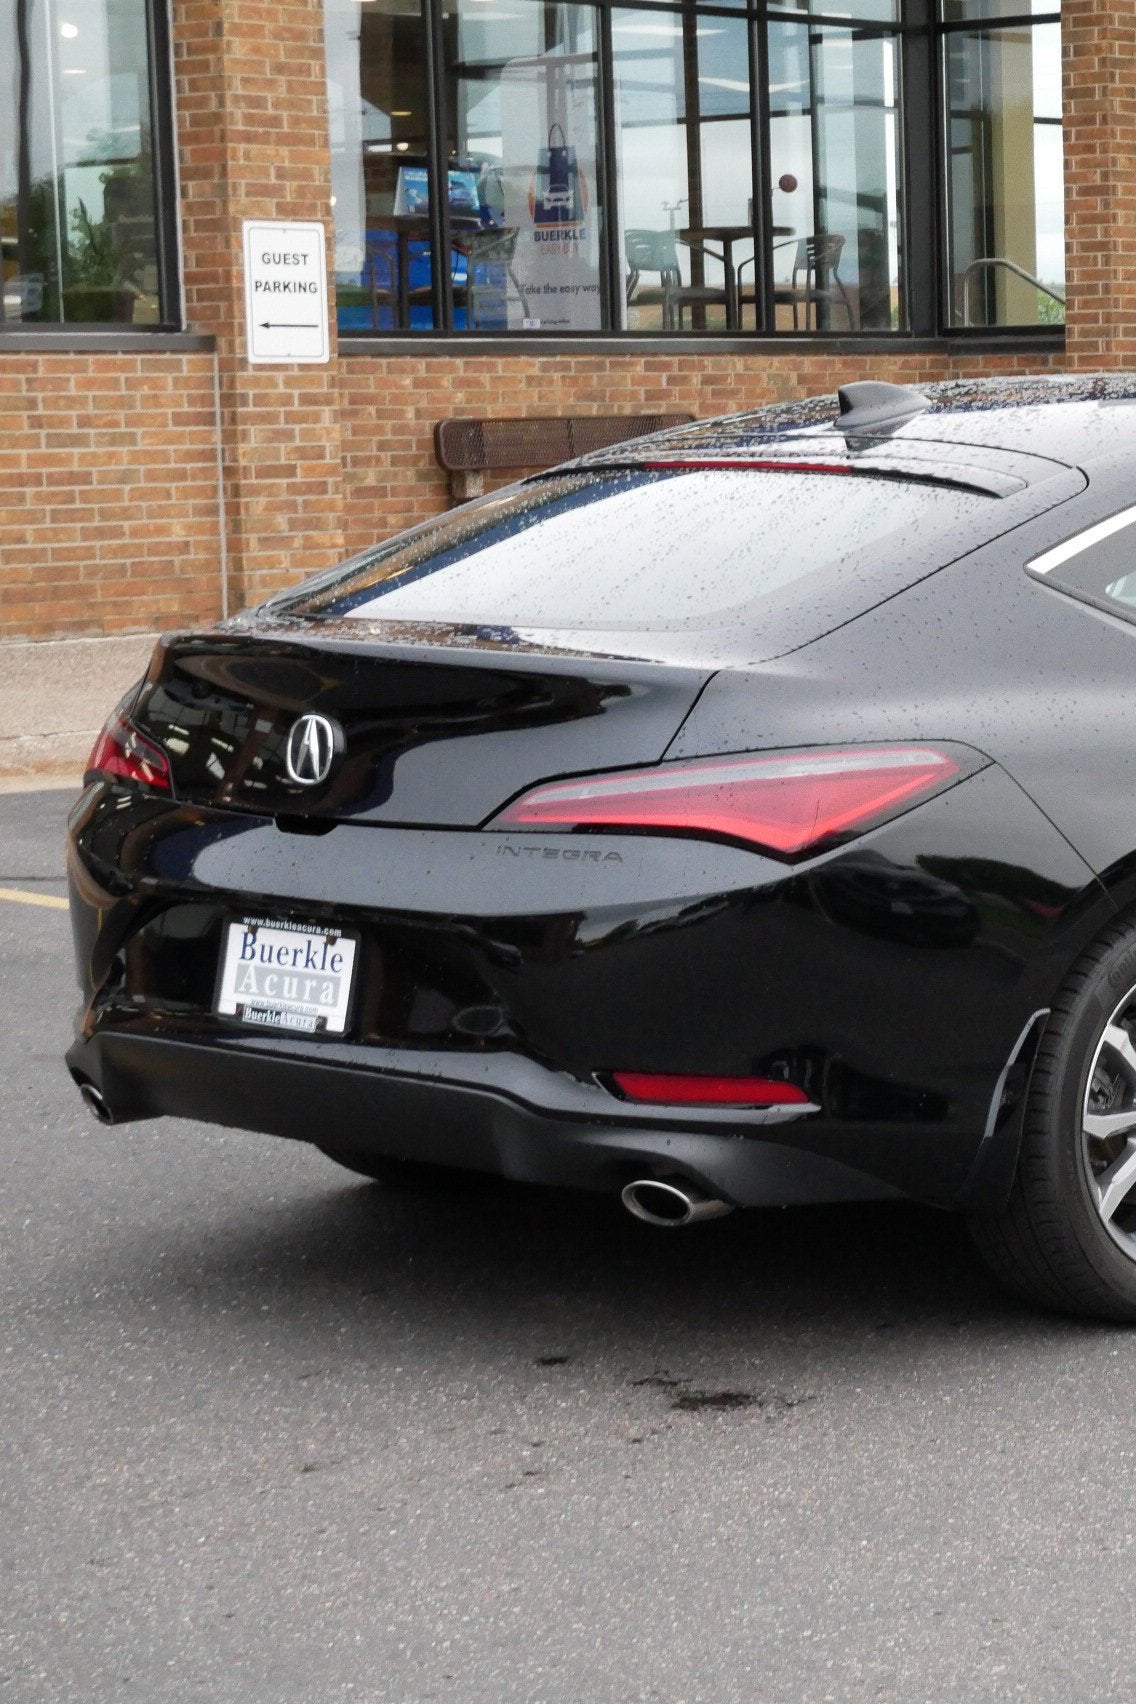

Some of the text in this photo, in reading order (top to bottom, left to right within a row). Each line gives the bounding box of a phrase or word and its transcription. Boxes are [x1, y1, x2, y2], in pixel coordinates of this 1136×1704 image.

[533, 228, 586, 242] BUERKLE
[261, 252, 309, 266] GUEST
[254, 280, 318, 294] PARKING
[543, 282, 557, 295] the
[560, 285, 580, 296] easy
[496, 845, 624, 863] INTEGRA
[243, 916, 342, 937] www.buerkleacura.com
[239, 931, 344, 973] Buerkle
[237, 963, 335, 1005] Acura
